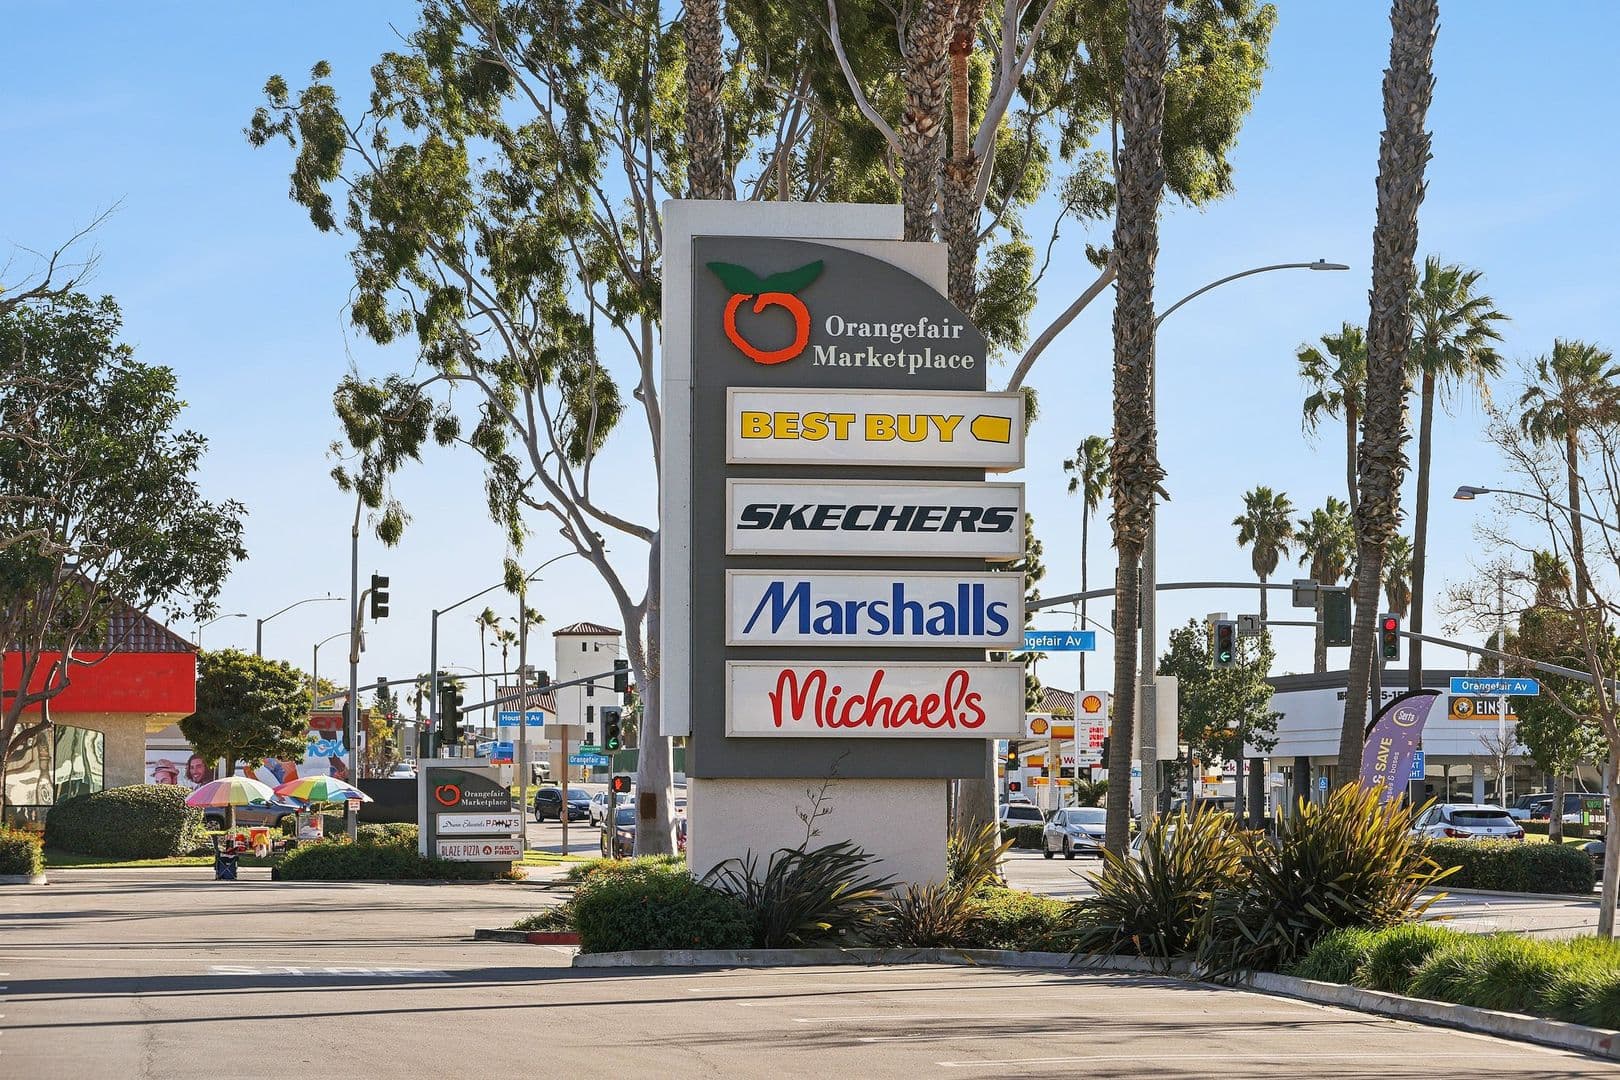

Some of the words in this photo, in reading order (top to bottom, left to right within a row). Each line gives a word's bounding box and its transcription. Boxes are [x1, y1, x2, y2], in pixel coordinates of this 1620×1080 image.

[825, 315, 964, 343] Orangefair
[813, 345, 975, 375] Marketplace
[741, 411, 856, 441] BEST
[864, 414, 964, 443] BUY
[736, 503, 1018, 533] SKECHERS
[742, 581, 1009, 637] Marshalls
[1065, 635, 1081, 646] Av
[768, 668, 986, 730] Michaels
[1461, 681, 1511, 692] Orangefair
[1514, 681, 1527, 691] Av
[1378, 737, 1392, 772] SAVE
[1389, 751, 1400, 775] bases
[461, 799, 508, 807] Marketplace
[464, 790, 505, 799] Orangefair
[441, 845, 460, 857] BLAZE
[463, 845, 481, 857] PIZZA
